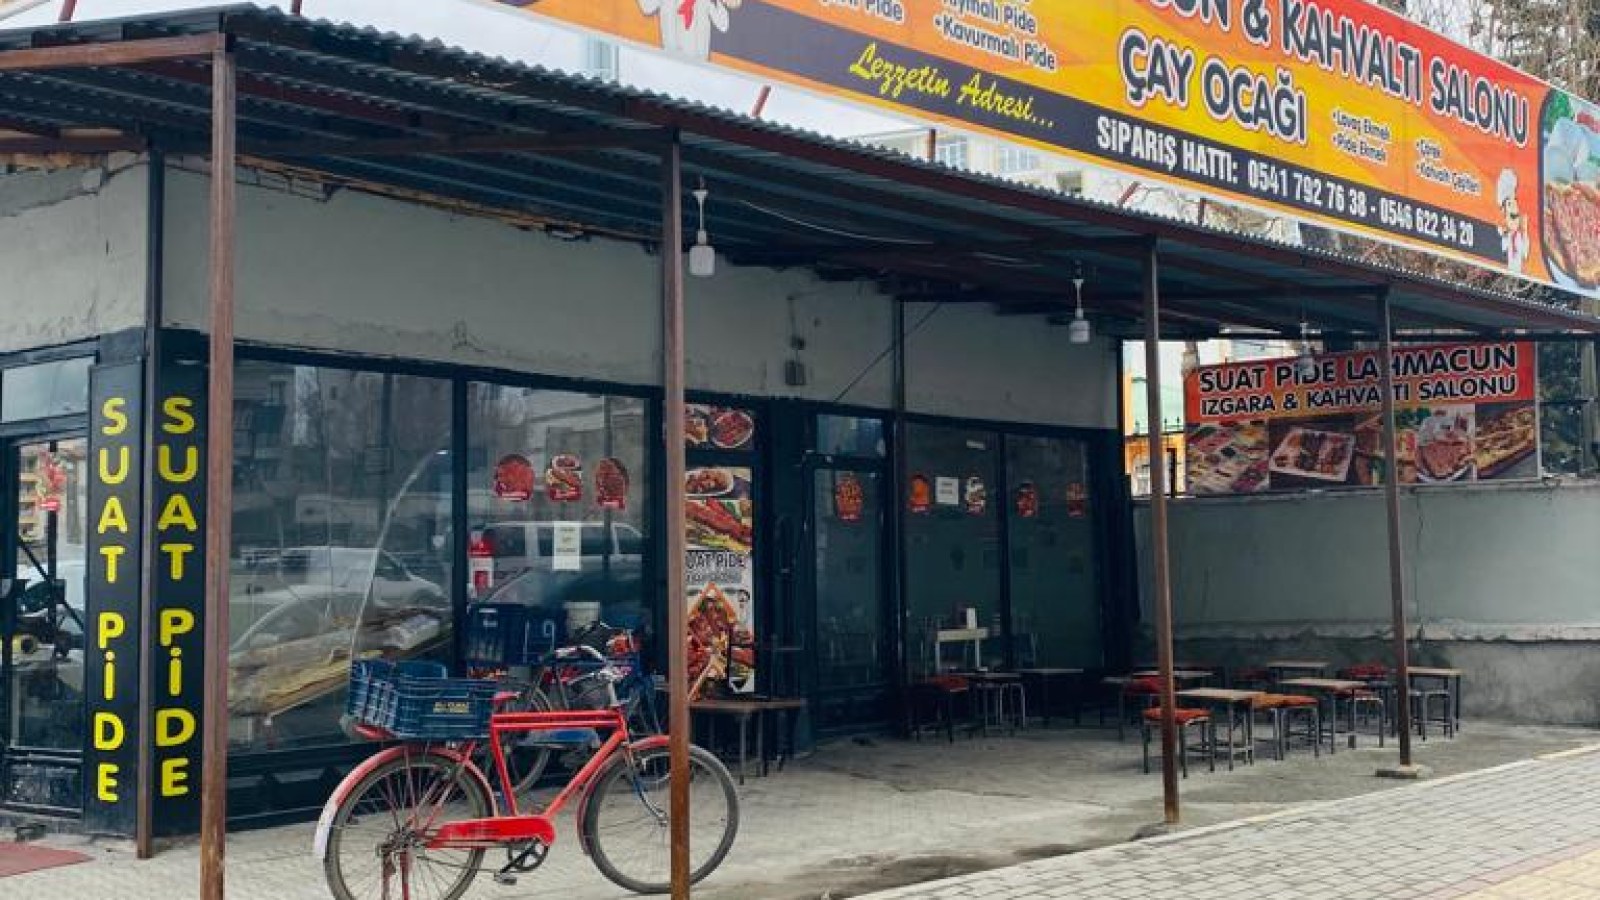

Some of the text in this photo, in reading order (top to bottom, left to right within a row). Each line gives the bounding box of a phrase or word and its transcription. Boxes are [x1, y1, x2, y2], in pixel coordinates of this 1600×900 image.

[943, 14, 1055, 70] Kavurmalı Pide
[1003, 5, 1035, 34] Pide
[849, 42, 951, 98] Lezzetin
[1121, 31, 1307, 144] ÇAY OCAĞI
[1282, 0, 1422, 105] KAHVALTI
[1430, 58, 1528, 145] SALONU
[1182, 138, 1239, 185] HATTI:
[1247, 160, 1288, 197] 0541
[1293, 172, 1323, 207] 792
[1326, 180, 1345, 213] 76
[1349, 188, 1368, 218] 38
[1380, 197, 1415, 230] 0546
[1416, 207, 1440, 238] 622
[1441, 214, 1457, 243] 34
[1459, 220, 1475, 248] 20
[1200, 367, 1267, 393] SUAT
[1201, 374, 1516, 416] IZGARA & KAHVATI SALONU
[97, 396, 130, 584] SUAT
[157, 395, 199, 582] SUAT
